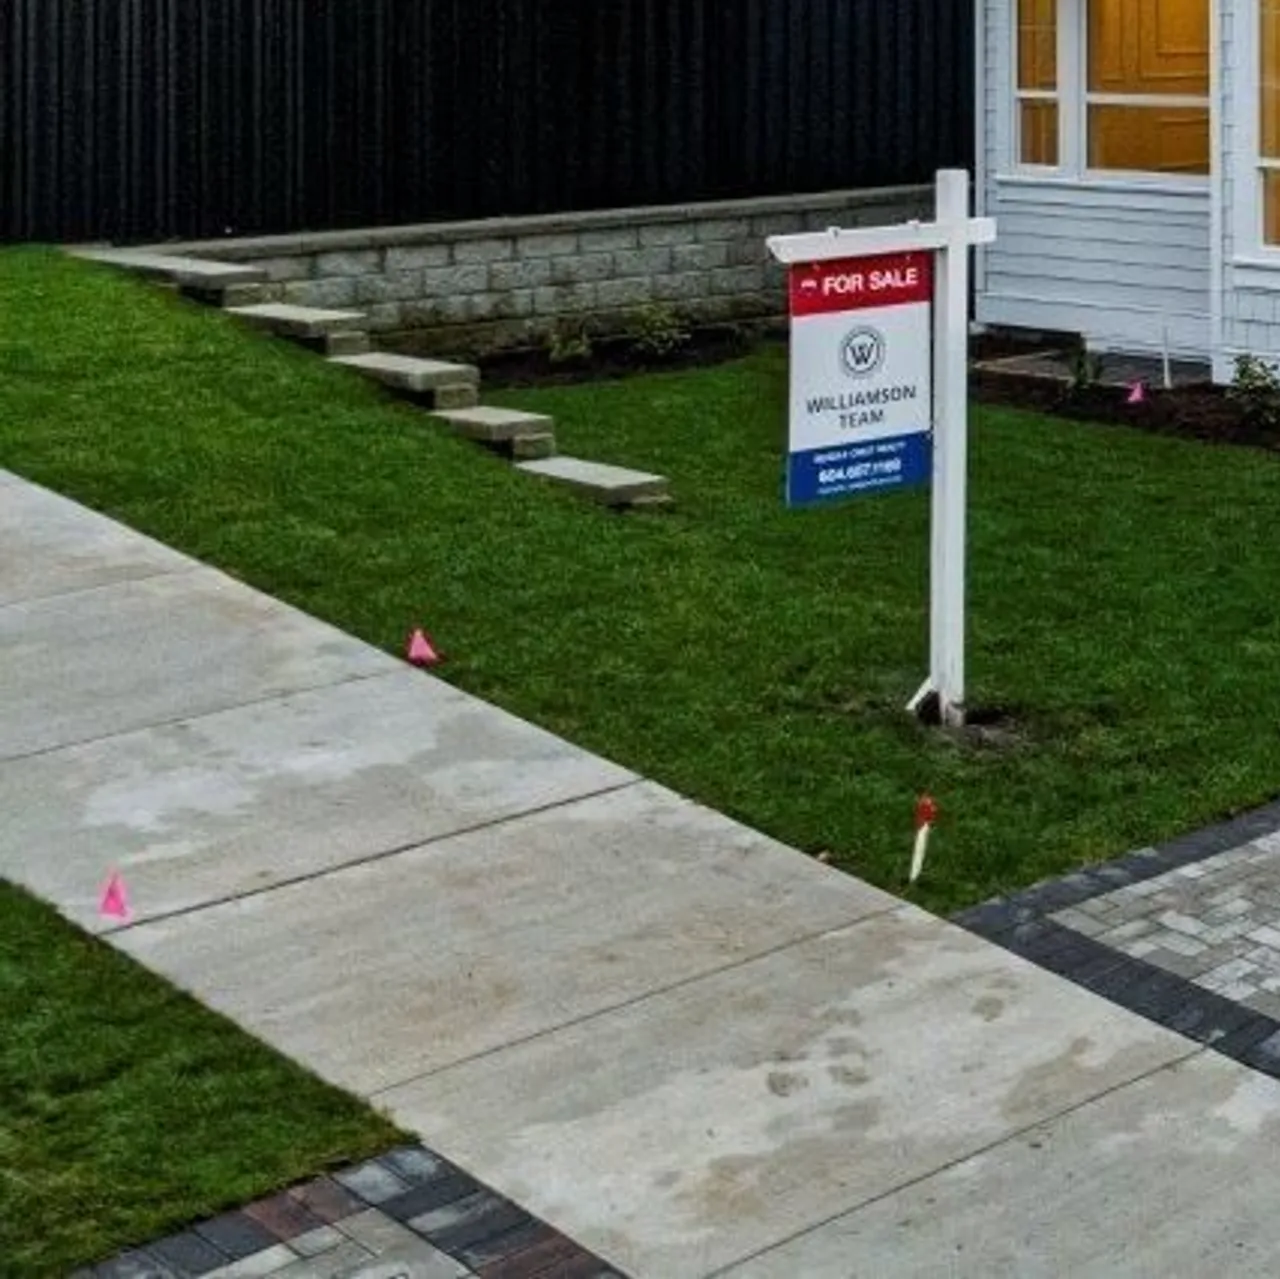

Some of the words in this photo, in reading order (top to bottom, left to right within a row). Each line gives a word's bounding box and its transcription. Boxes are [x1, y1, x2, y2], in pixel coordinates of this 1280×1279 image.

[822, 273, 864, 296] FOR
[868, 268, 919, 291] SALE
[849, 342, 876, 366] W
[806, 385, 917, 414] WILLIAMSON
[838, 409, 884, 429] TEAM
